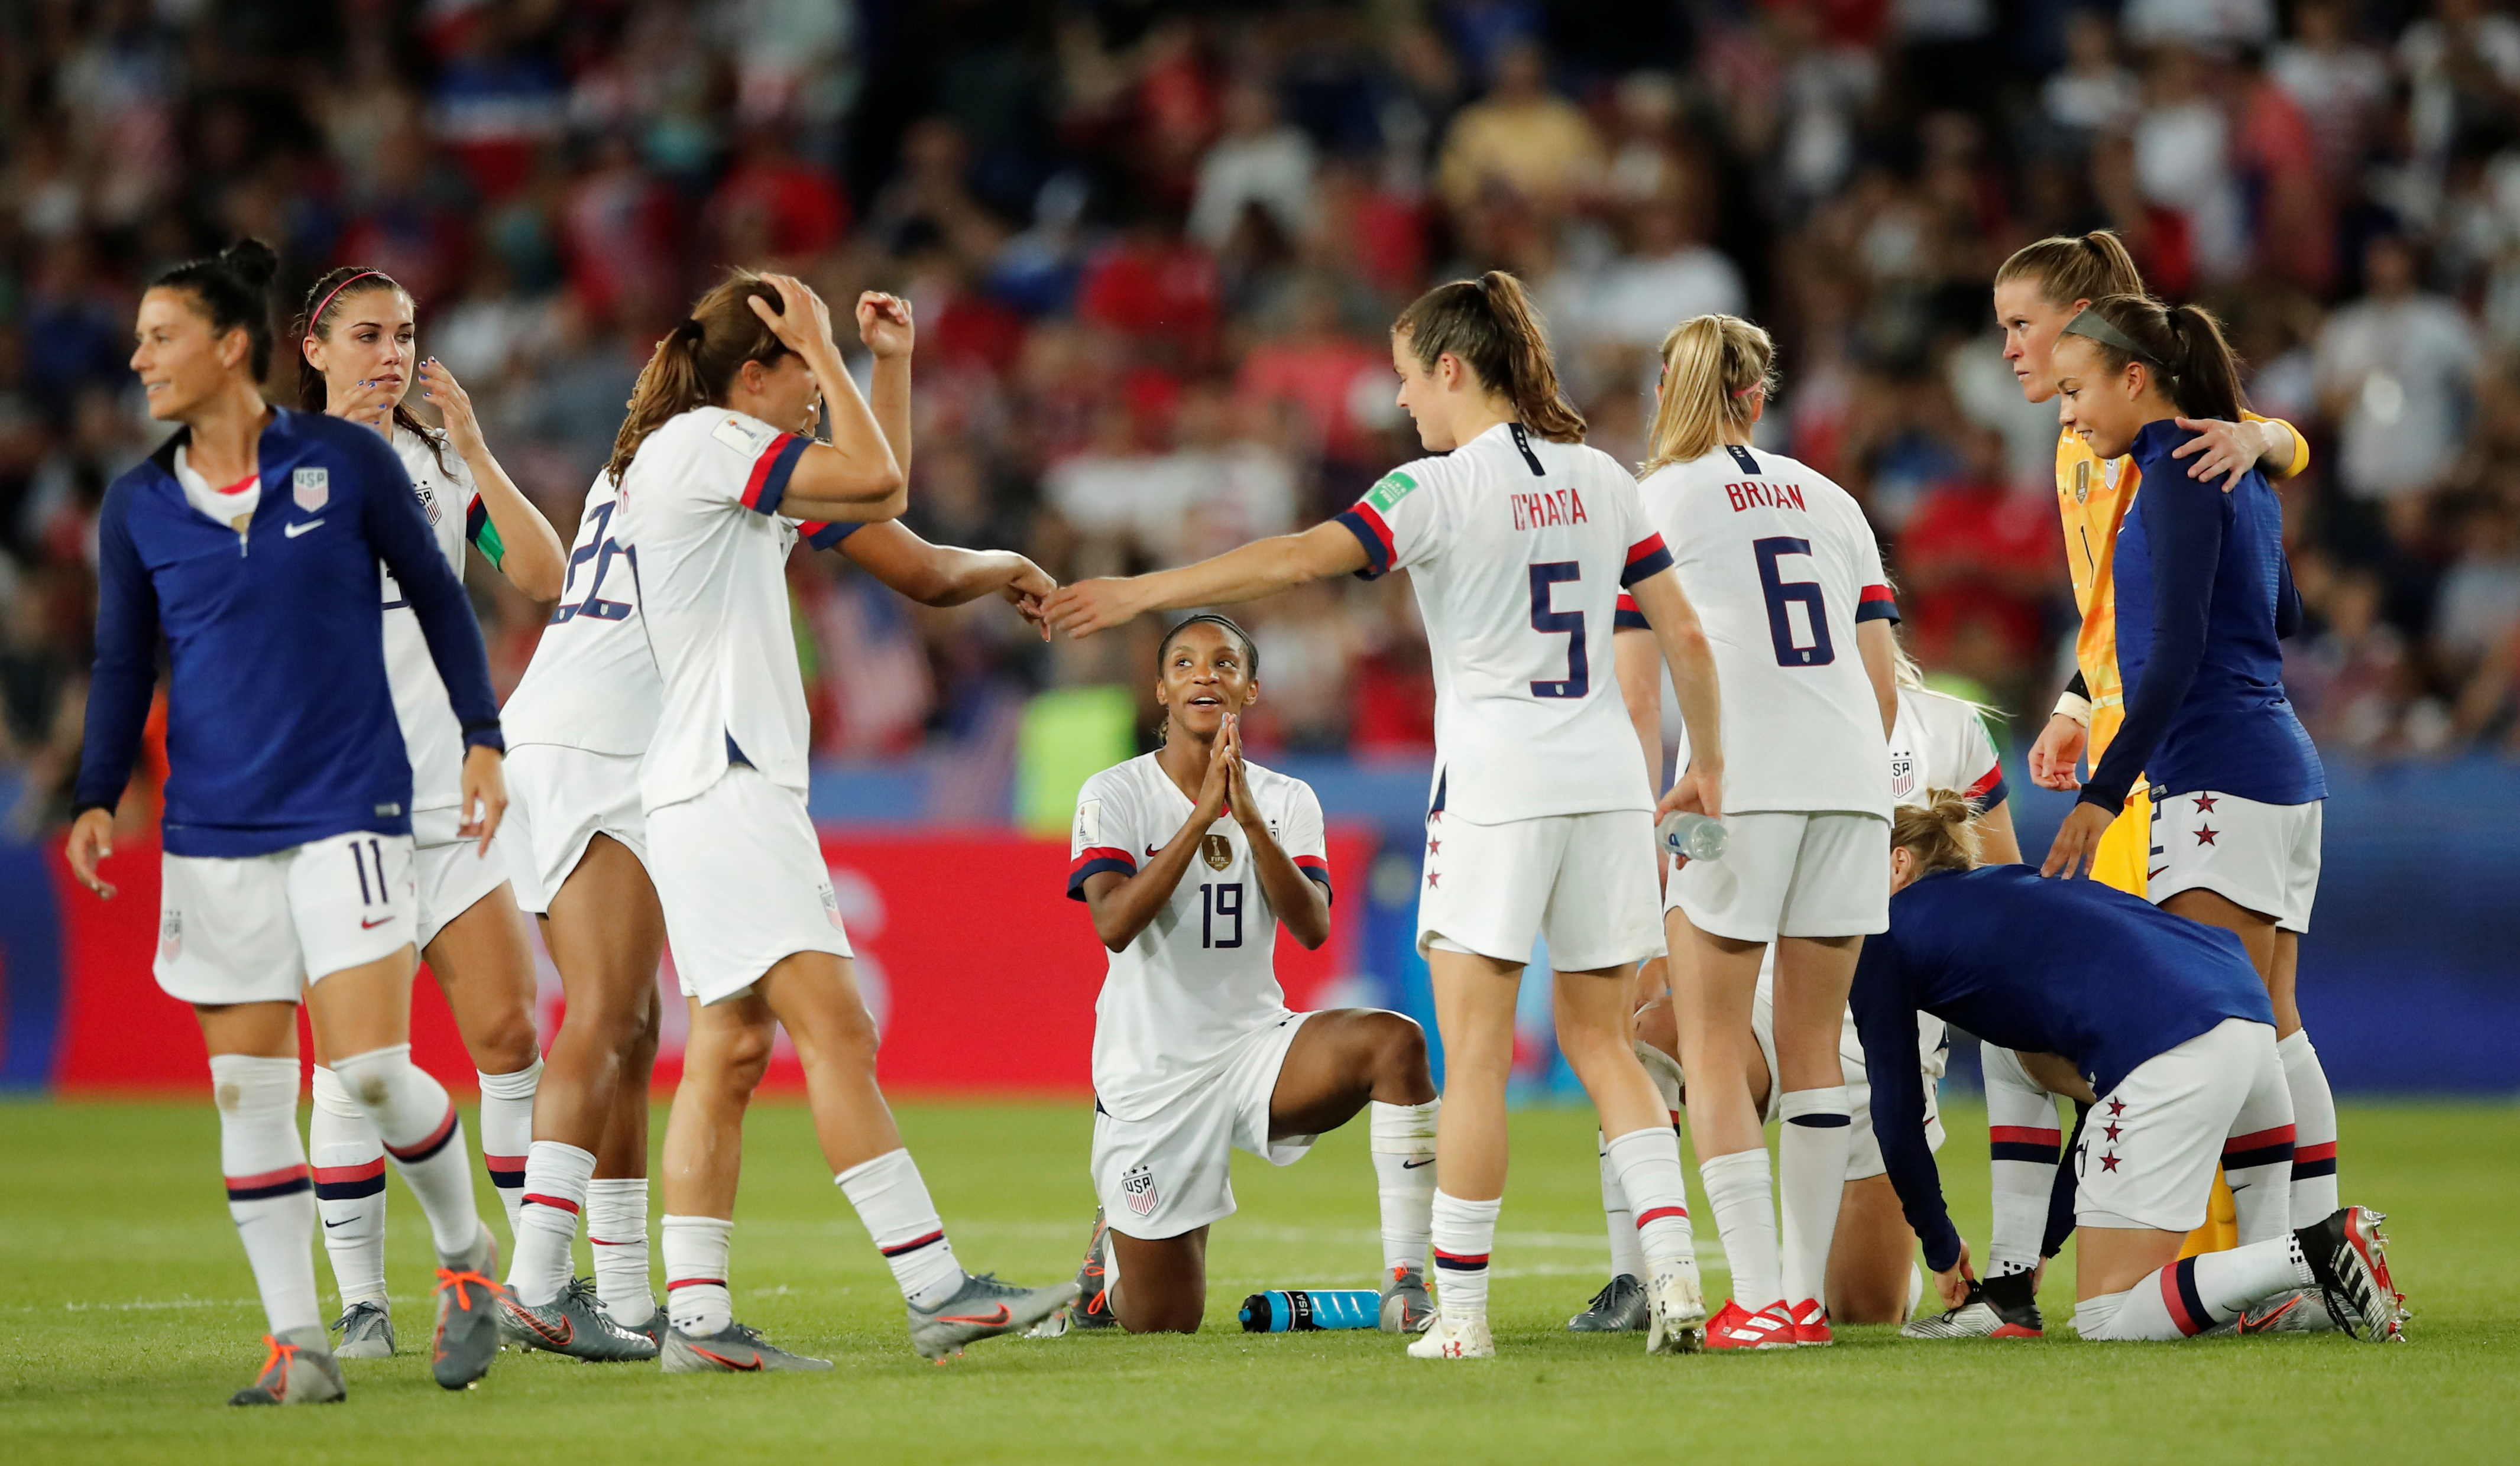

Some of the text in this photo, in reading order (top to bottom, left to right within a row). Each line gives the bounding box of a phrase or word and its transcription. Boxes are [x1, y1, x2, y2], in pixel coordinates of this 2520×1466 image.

[416, 491, 432, 506] SA
[1725, 482, 1806, 513] BRIAN
[1753, 536, 1835, 667] 6
[1528, 561, 1589, 699] 5
[1893, 762, 1910, 777] SA
[349, 839, 389, 906] 11
[1200, 883, 1243, 949] 19
[1125, 1176, 1151, 1194] USA
[1296, 1294, 1309, 1316] USA
